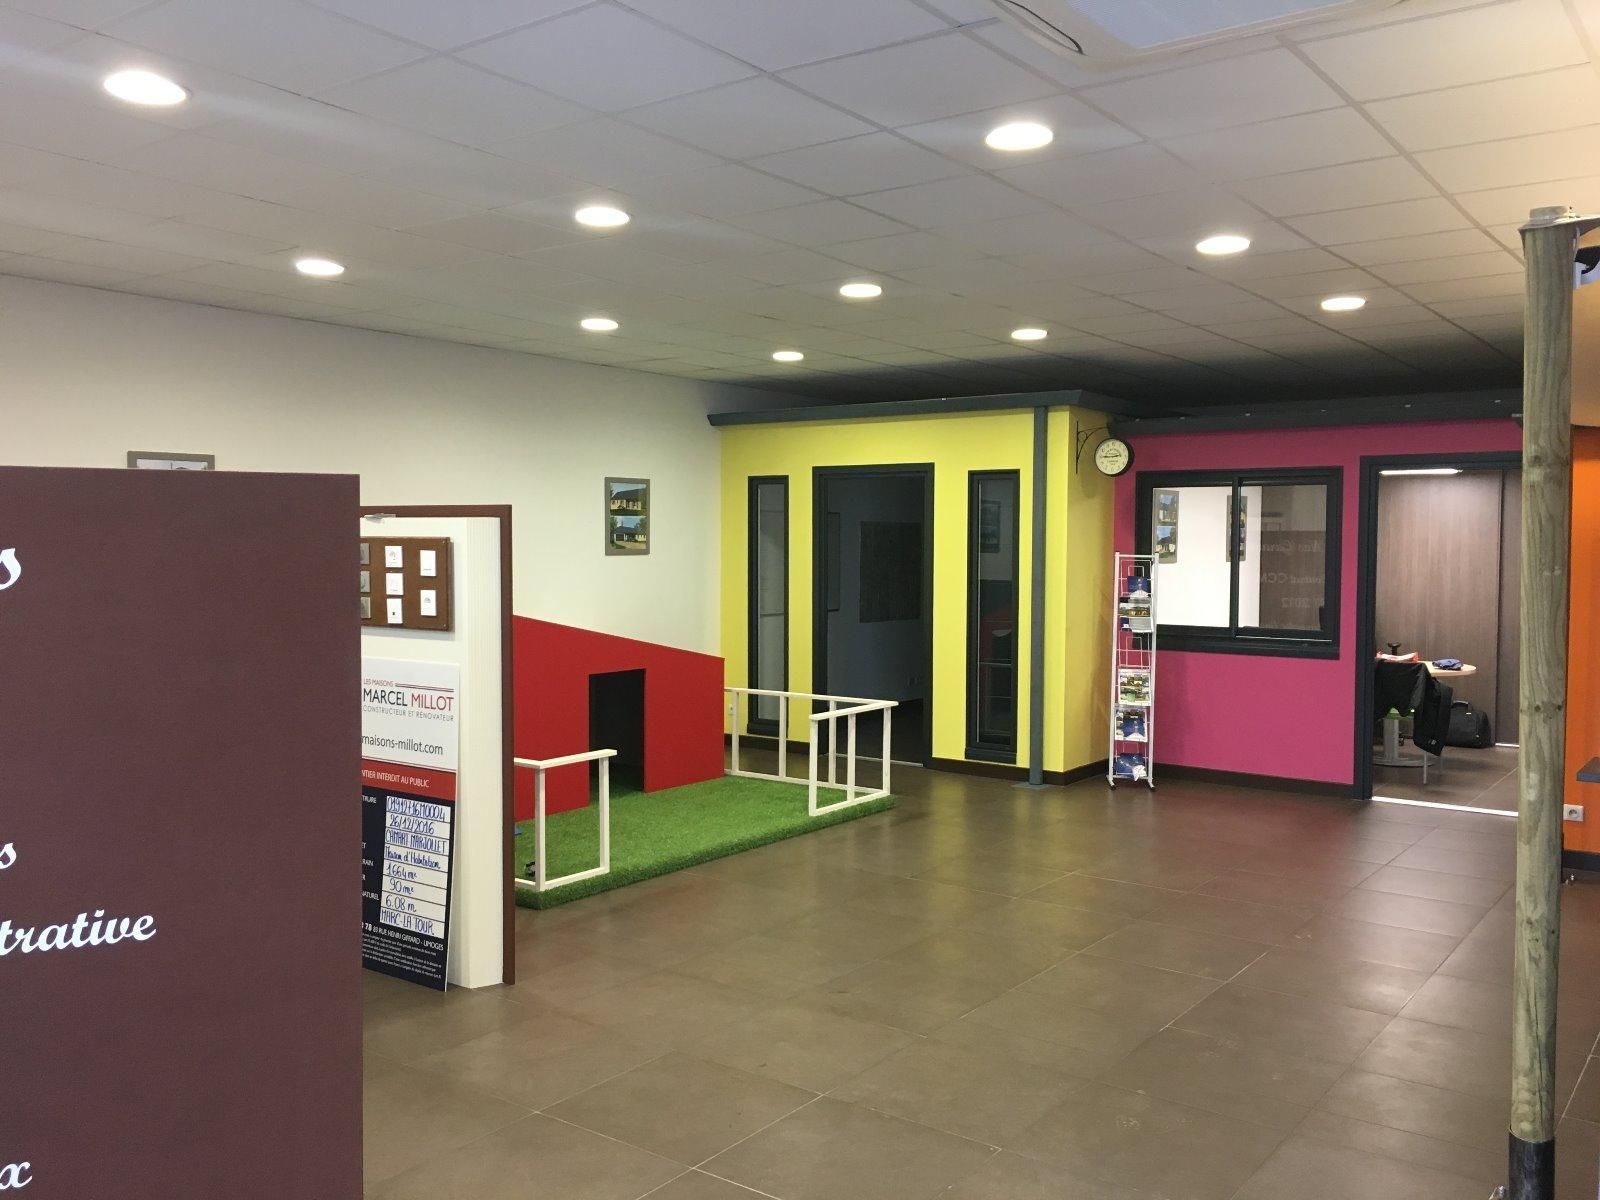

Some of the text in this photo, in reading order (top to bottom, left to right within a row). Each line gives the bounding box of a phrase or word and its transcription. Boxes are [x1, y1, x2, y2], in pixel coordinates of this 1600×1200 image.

[363, 678, 394, 687] LES MAISONS
[363, 688, 455, 711] MARCEL MILLOT
[362, 705, 406, 716] CONSTRUCTEUR
[362, 735, 444, 755] maisons-millot.com
[376, 772, 400, 782] INTERDIT
[400, 776, 408, 784] AU
[409, 777, 430, 788] PUBLIC
[0, 909, 157, 956] trative
[379, 927, 387, 935] RUE
[423, 940, 444, 951] LIMOGES
